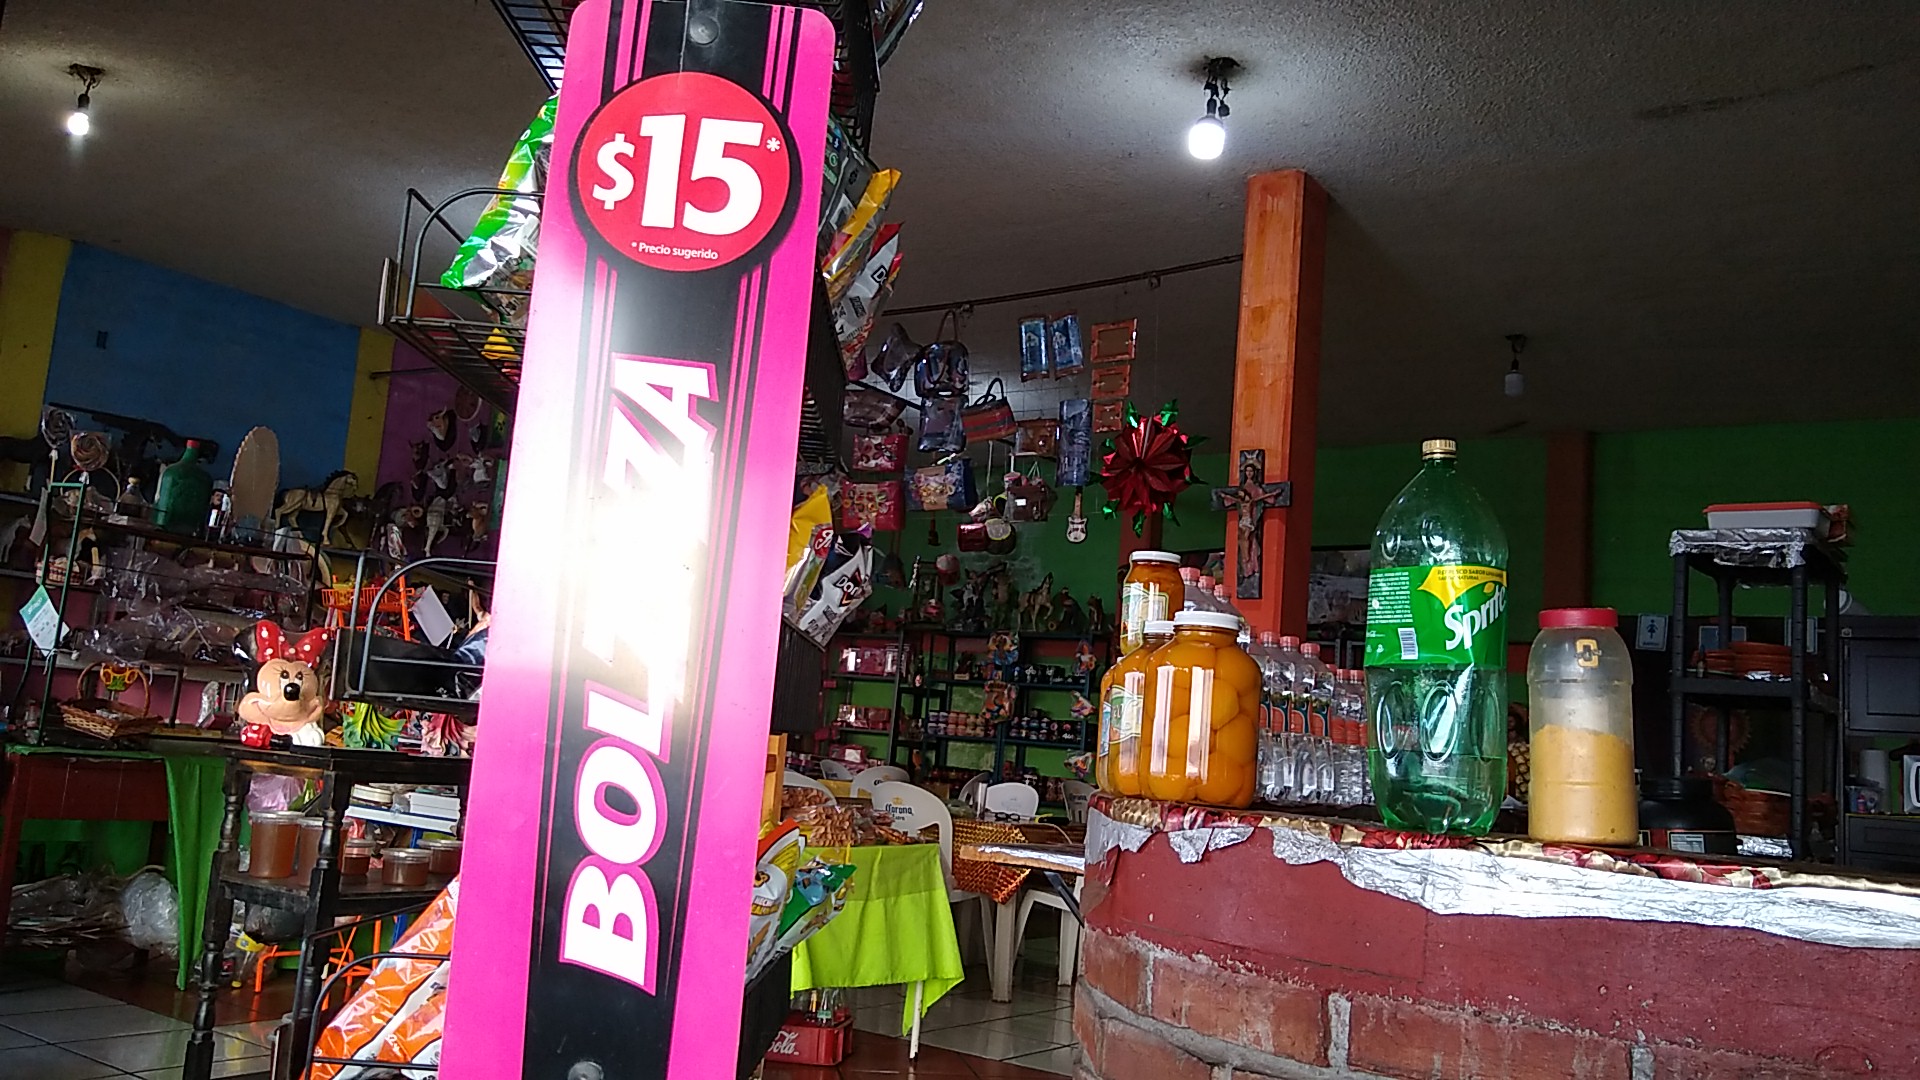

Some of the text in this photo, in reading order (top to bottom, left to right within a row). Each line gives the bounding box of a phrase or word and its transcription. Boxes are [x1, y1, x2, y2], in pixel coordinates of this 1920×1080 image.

[637, 241, 719, 260] Precio sugerido
[1443, 583, 1507, 650] Sprite
[885, 803, 914, 816] Corona
